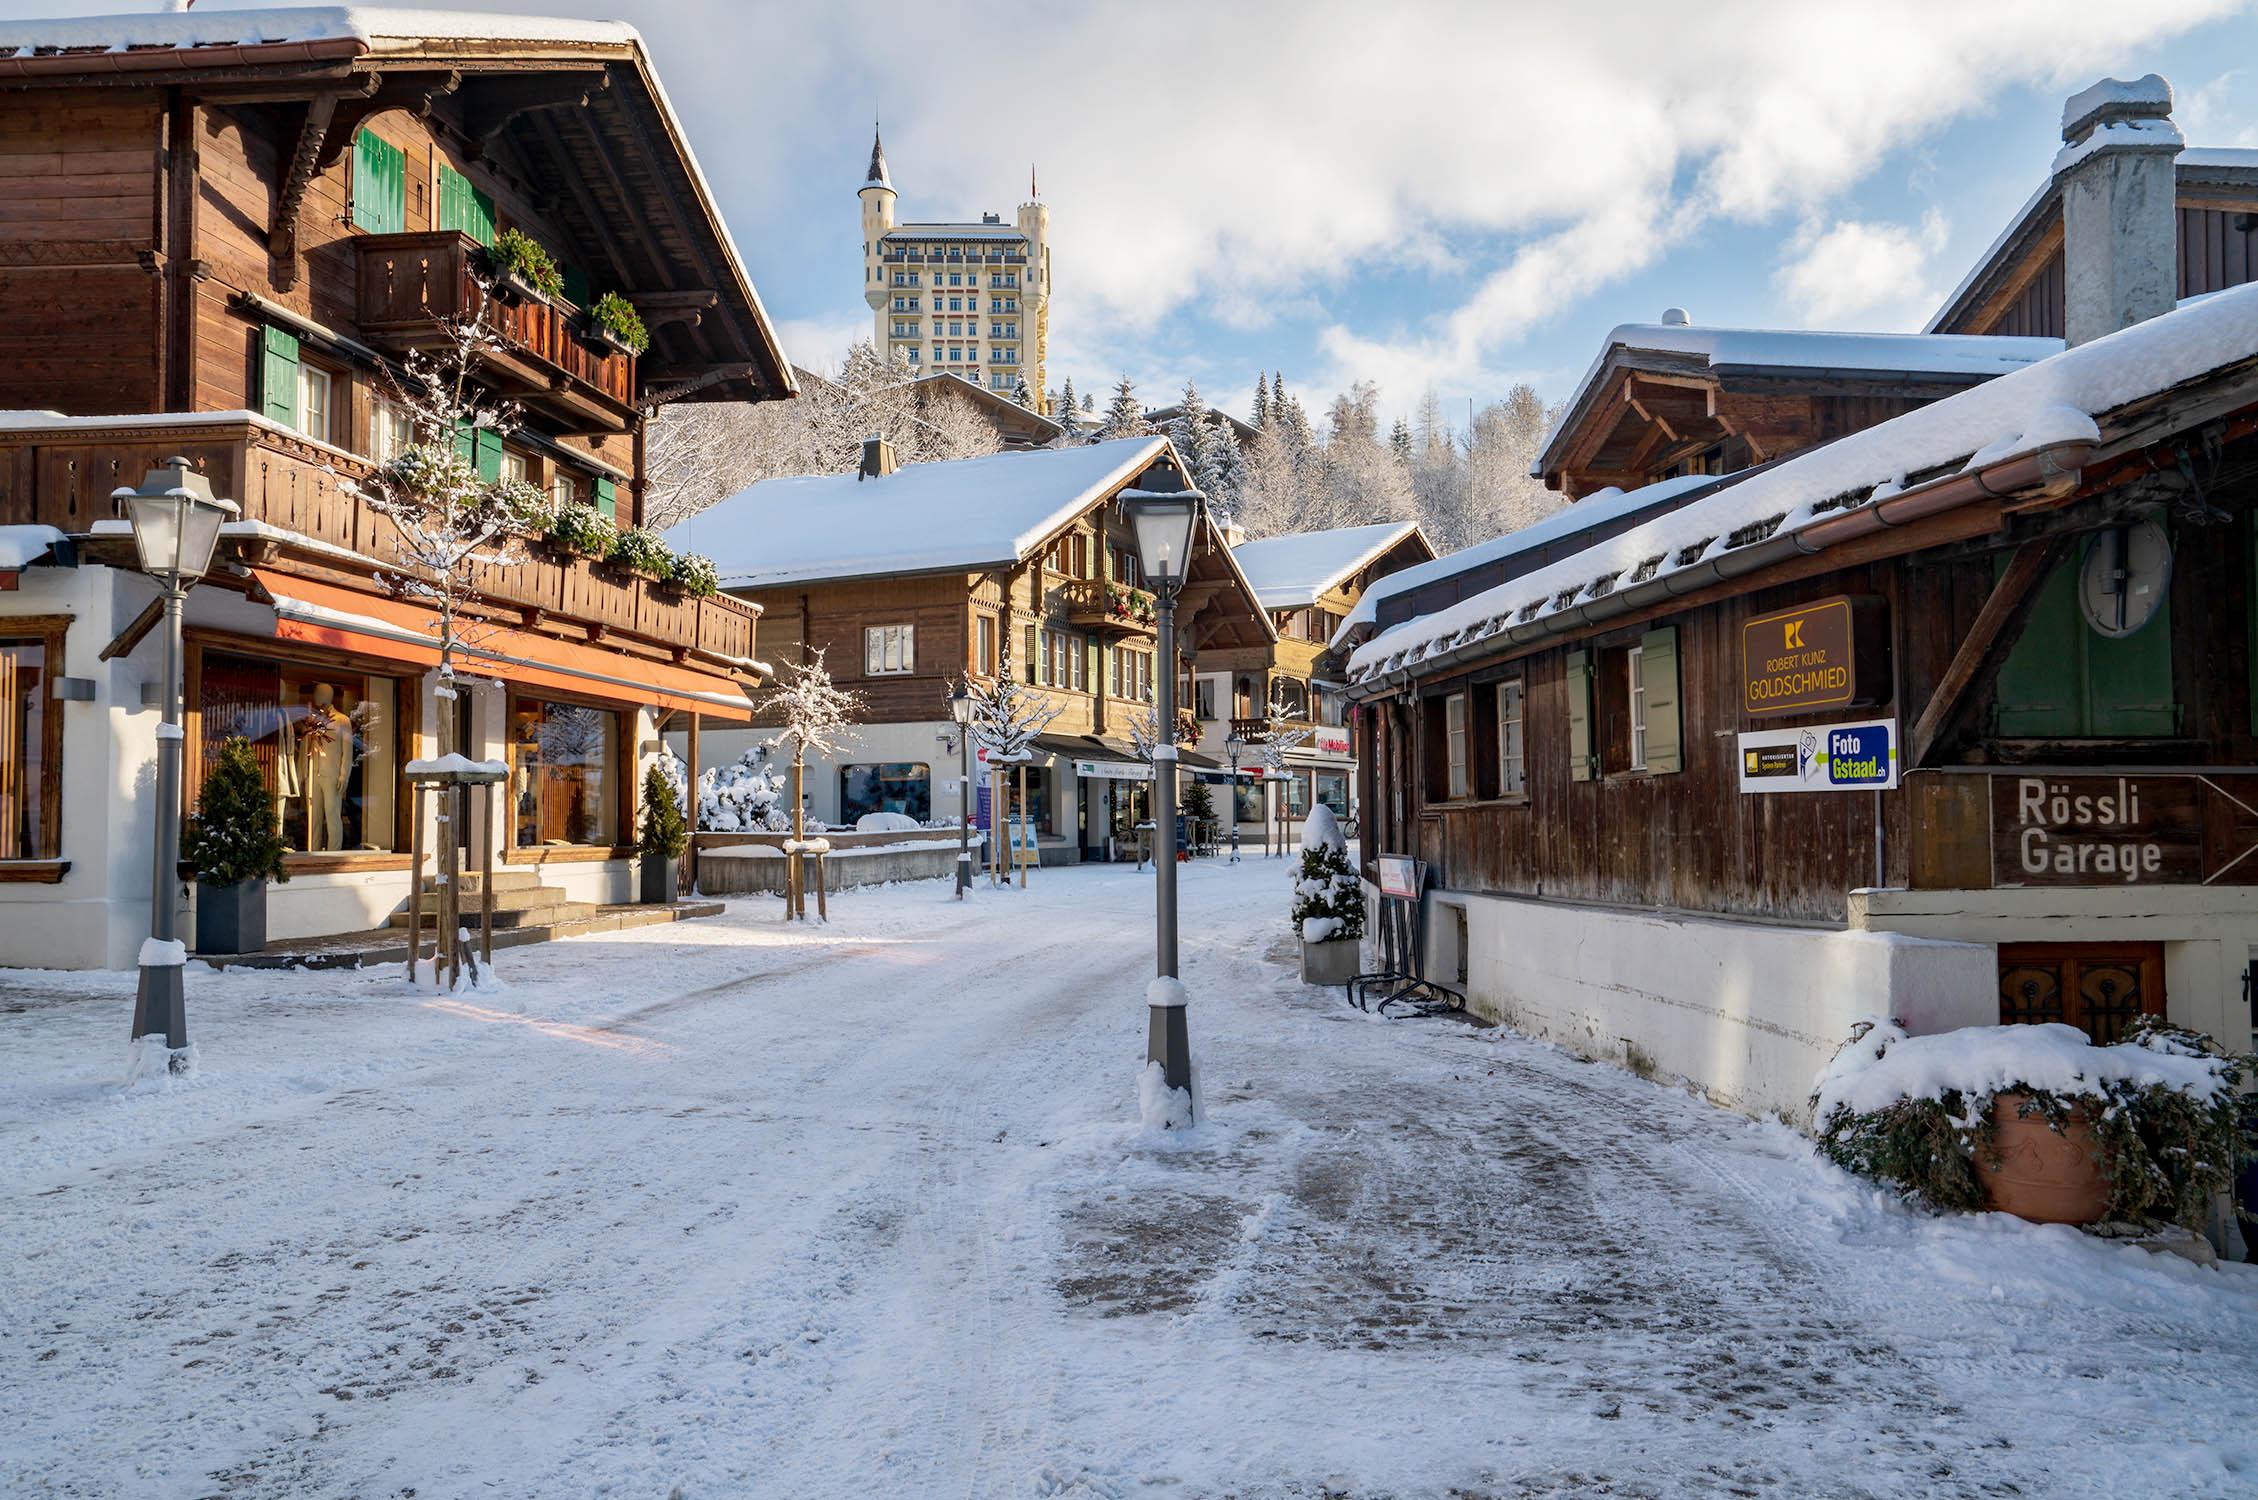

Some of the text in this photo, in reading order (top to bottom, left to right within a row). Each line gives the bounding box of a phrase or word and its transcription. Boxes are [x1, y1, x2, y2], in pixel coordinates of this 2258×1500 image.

[1766, 650, 1826, 673] ROBERT KUNZ
[1749, 666, 1846, 700] GOLDSCHMIED
[1832, 734, 1860, 755] Foto
[1833, 756, 1886, 780] Gstaad.ch
[2019, 778, 2139, 825] Rössli
[2021, 827, 2161, 882] Garage
